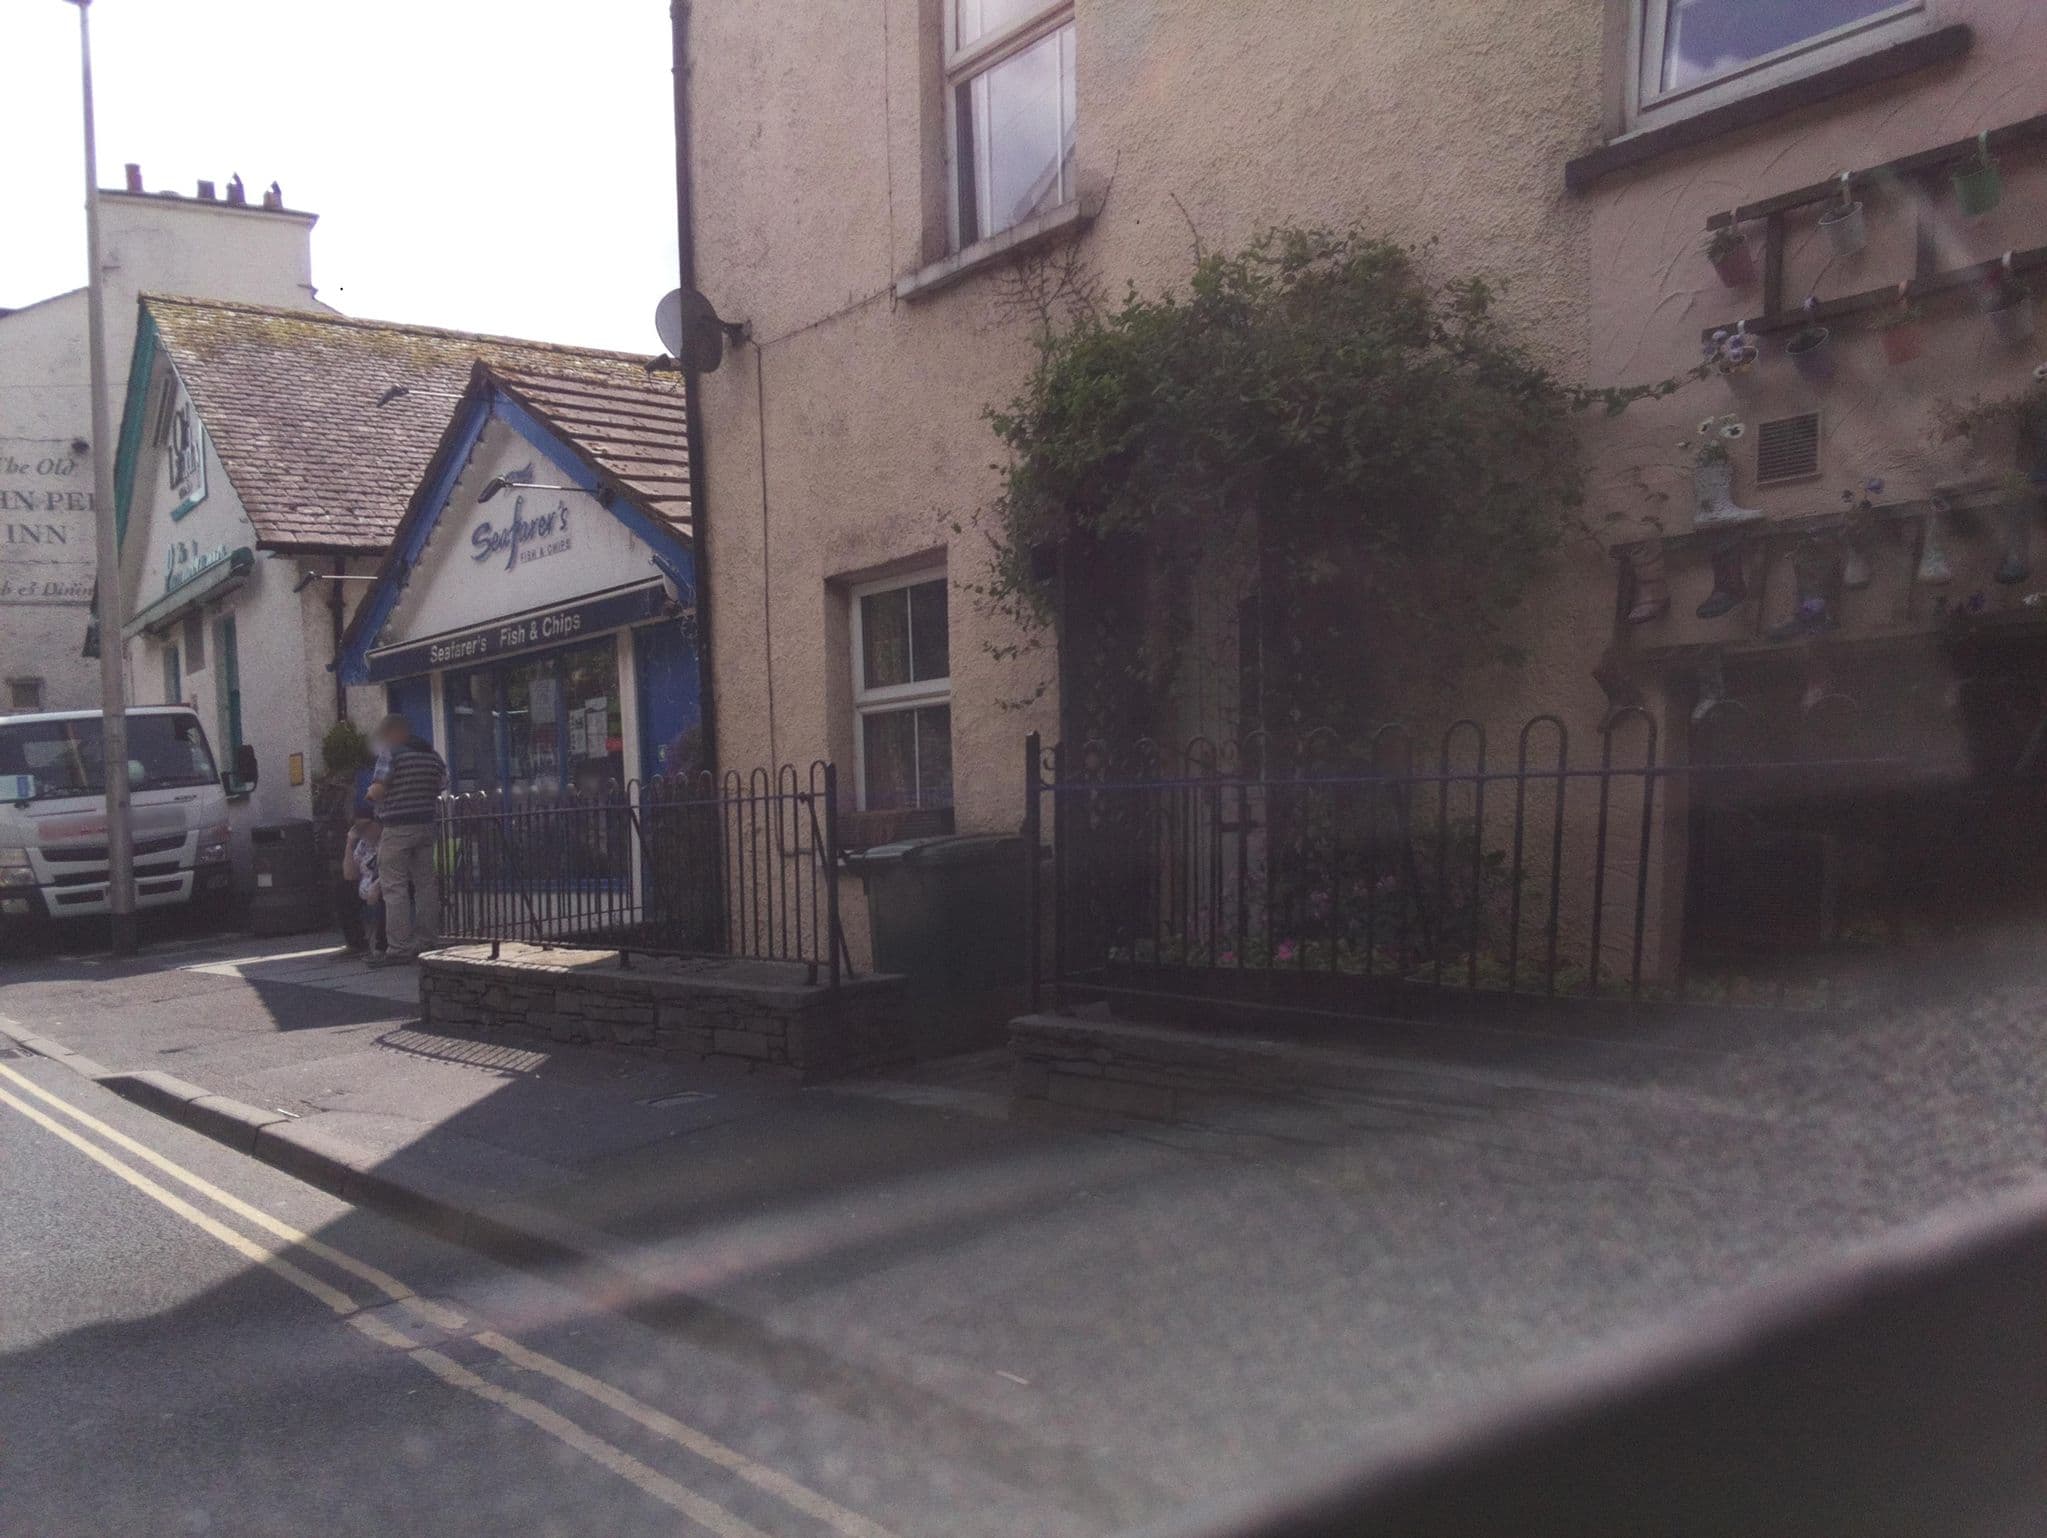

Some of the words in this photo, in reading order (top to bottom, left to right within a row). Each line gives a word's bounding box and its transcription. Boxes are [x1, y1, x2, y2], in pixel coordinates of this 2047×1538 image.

[37, 458, 75, 475] Old
[5, 524, 66, 544] INN
[471, 495, 568, 571] Seafarer's
[430, 635, 487, 663] Seafarer's
[500, 625, 525, 648] Fish
[530, 620, 538, 640] &
[542, 613, 581, 637] Chips
